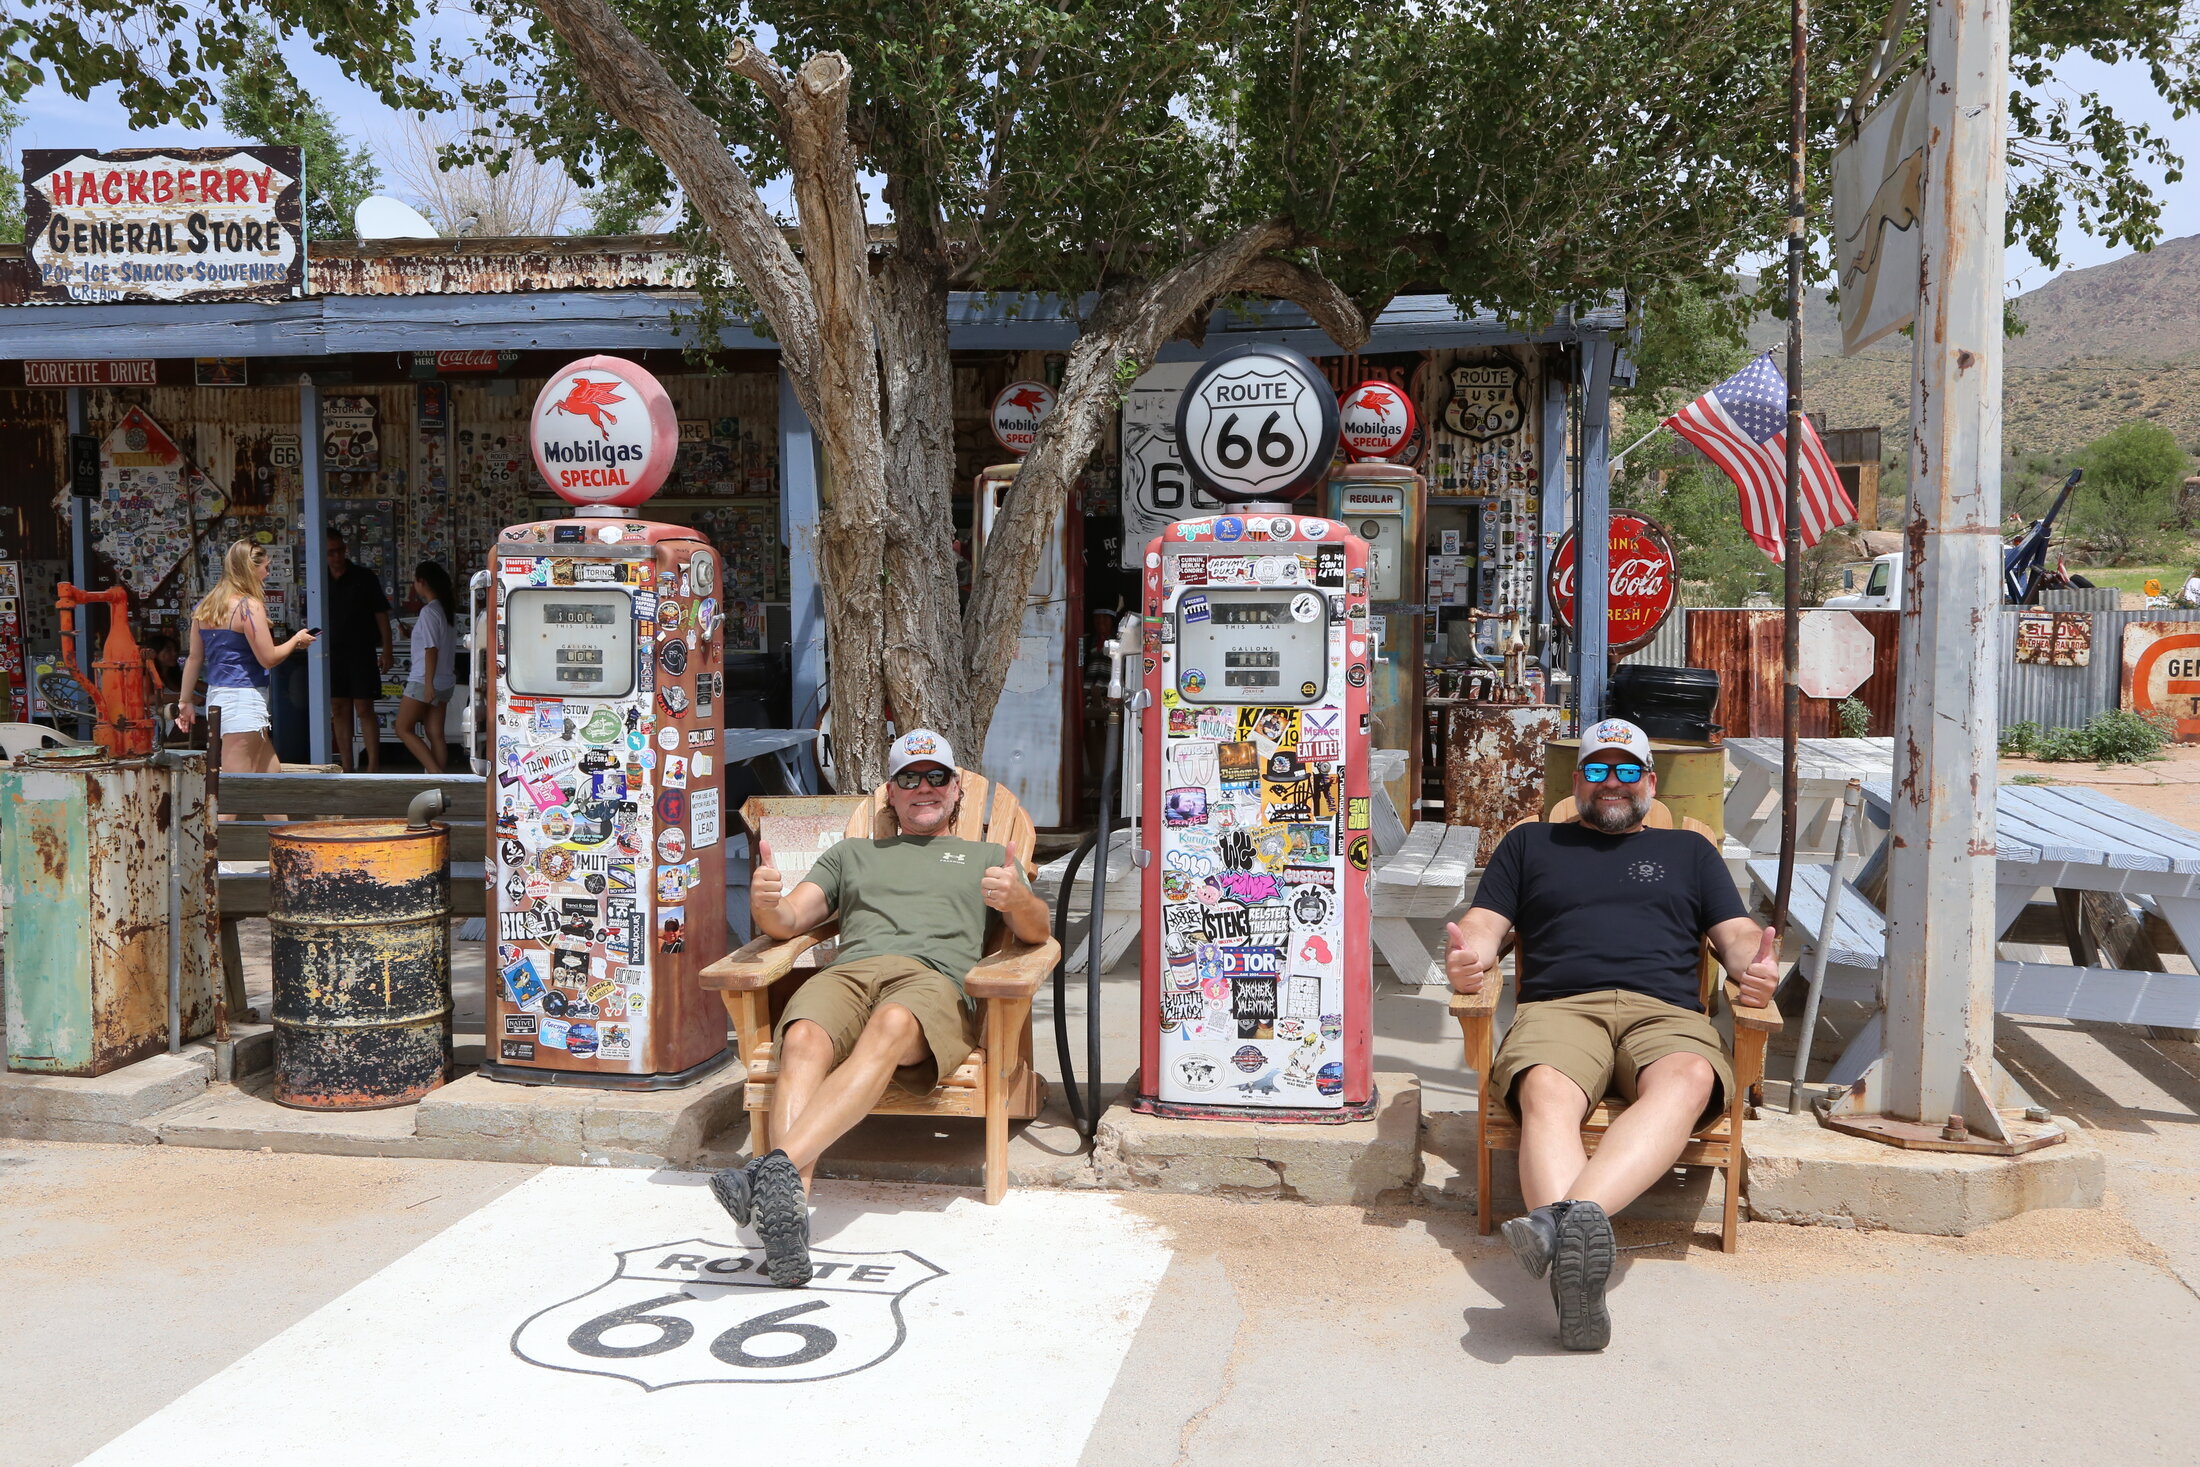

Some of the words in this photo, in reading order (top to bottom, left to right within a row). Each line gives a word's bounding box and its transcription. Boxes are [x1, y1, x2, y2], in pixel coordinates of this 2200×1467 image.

[52, 166, 272, 206] HACKBERRY
[50, 213, 177, 253] GENERAL
[187, 214, 280, 252] STORE
[84, 262, 110, 281] ICE
[121, 262, 184, 281] SNACKS
[197, 262, 286, 280] SOUVENIRS
[414, 357, 435, 366] HERE
[497, 353, 518, 361] COLD
[31, 363, 100, 383] CORVETTE
[110, 362, 149, 382] DRIVE
[1460, 371, 1508, 384] ROUTE
[1217, 382, 1288, 402] ROUTE
[1460, 403, 1502, 431] 66
[998, 418, 1039, 435] Mobilg
[1344, 421, 1401, 438] Mobilgas
[1006, 433, 1036, 444] SPECI
[1215, 410, 1294, 470] 66
[1353, 437, 1392, 448] SPECIAL
[274, 447, 296, 464] 66
[544, 440, 643, 469] Mobilgas
[490, 468, 510, 481] 66
[560, 468, 630, 488] SPECIAL
[1350, 494, 1393, 504] REGULAR
[1608, 537, 1639, 552] INK
[586, 569, 613, 577] TORINO
[265, 595, 284, 603] ARE
[1608, 608, 1651, 625] RESH!
[2028, 623, 2083, 636] SLOW
[2016, 639, 2051, 650] OVERHEA
[509, 719, 520, 727] 66
[1297, 742, 1312, 757] EAT
[1316, 740, 1338, 756] LIFE!
[694, 810, 716, 822] CONTAINS
[697, 821, 714, 835] LEAD
[581, 854, 607, 871] MUT
[1248, 907, 1288, 920] RELSTER
[1249, 920, 1288, 933] THEAMER
[1250, 933, 1289, 948] TAZ
[1238, 981, 1272, 999] ARCHER
[509, 1018, 532, 1027] NATIVE
[655, 1253, 896, 1283] ROTE
[566, 1291, 838, 1368] 66
